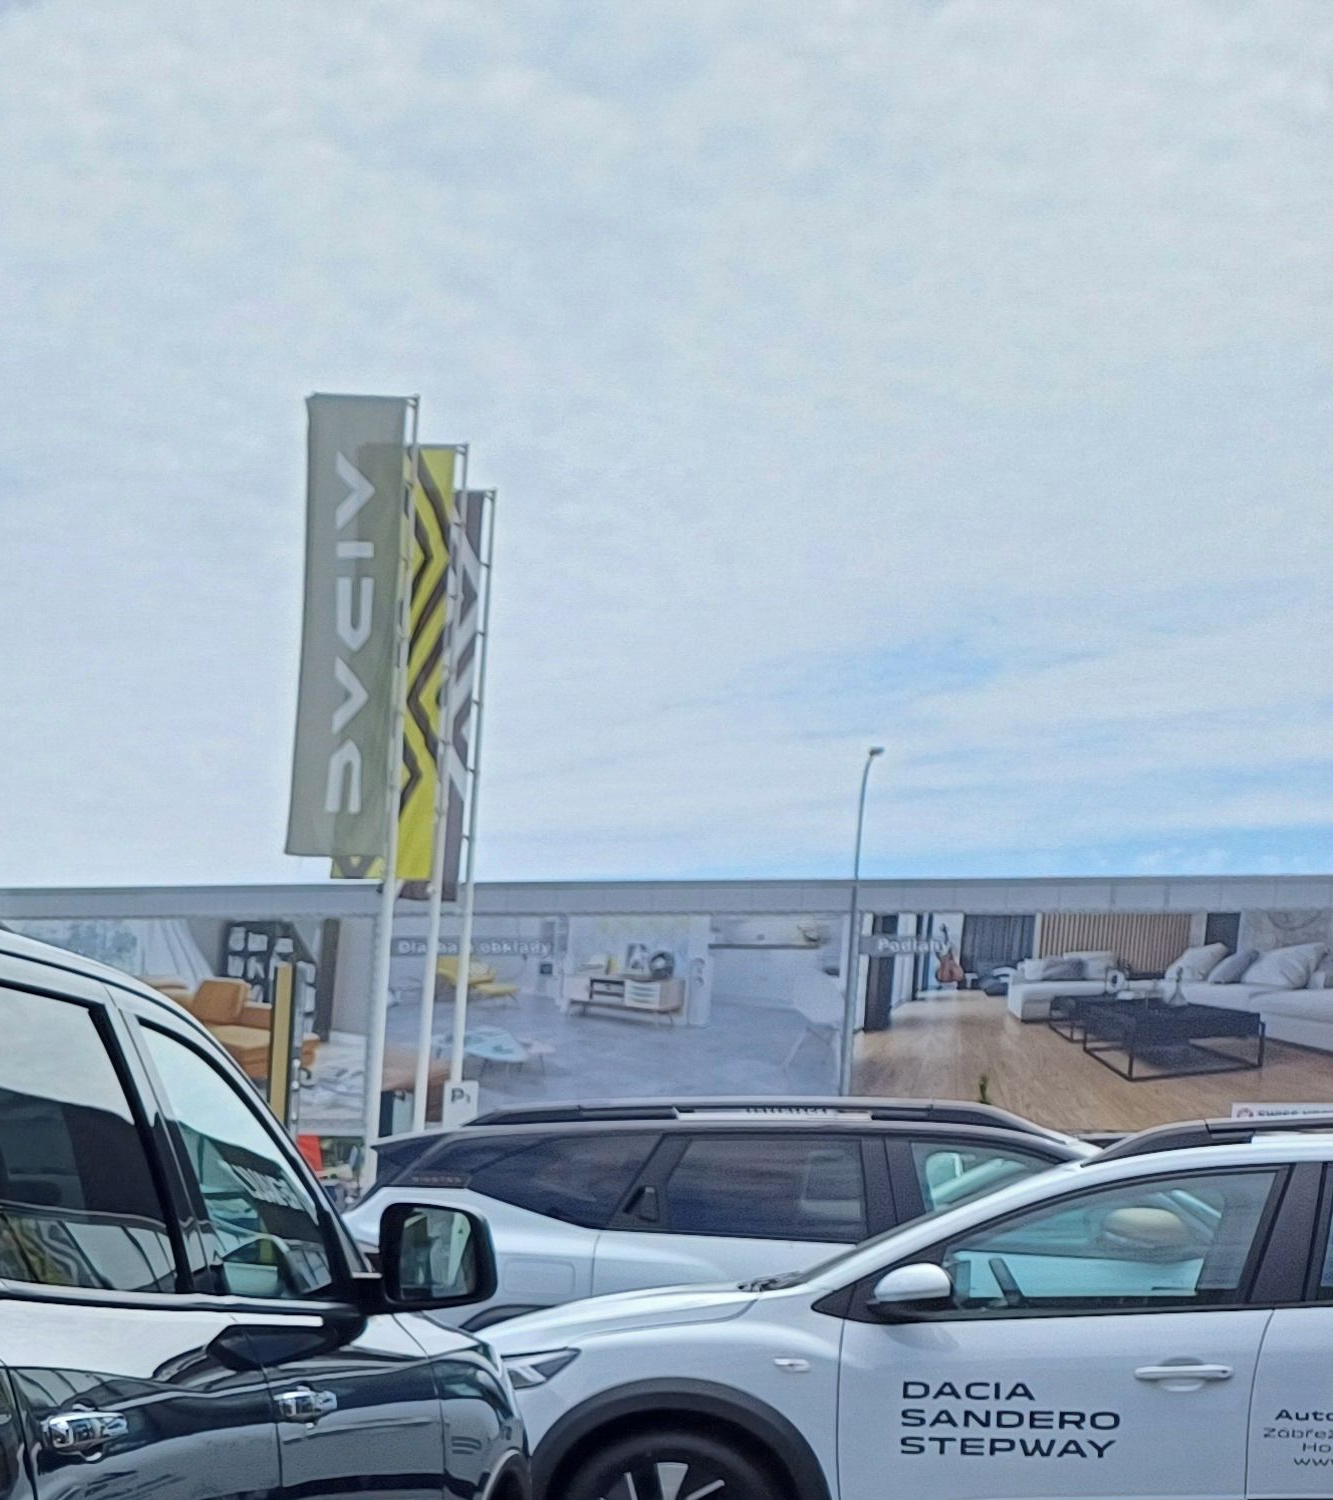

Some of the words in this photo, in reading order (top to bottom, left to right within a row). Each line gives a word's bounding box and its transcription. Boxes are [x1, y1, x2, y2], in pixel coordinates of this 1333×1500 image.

[903, 1381, 1035, 1400] DACIA
[901, 1409, 1121, 1430] SANDERO
[901, 1437, 1116, 1458] STEPWAY
